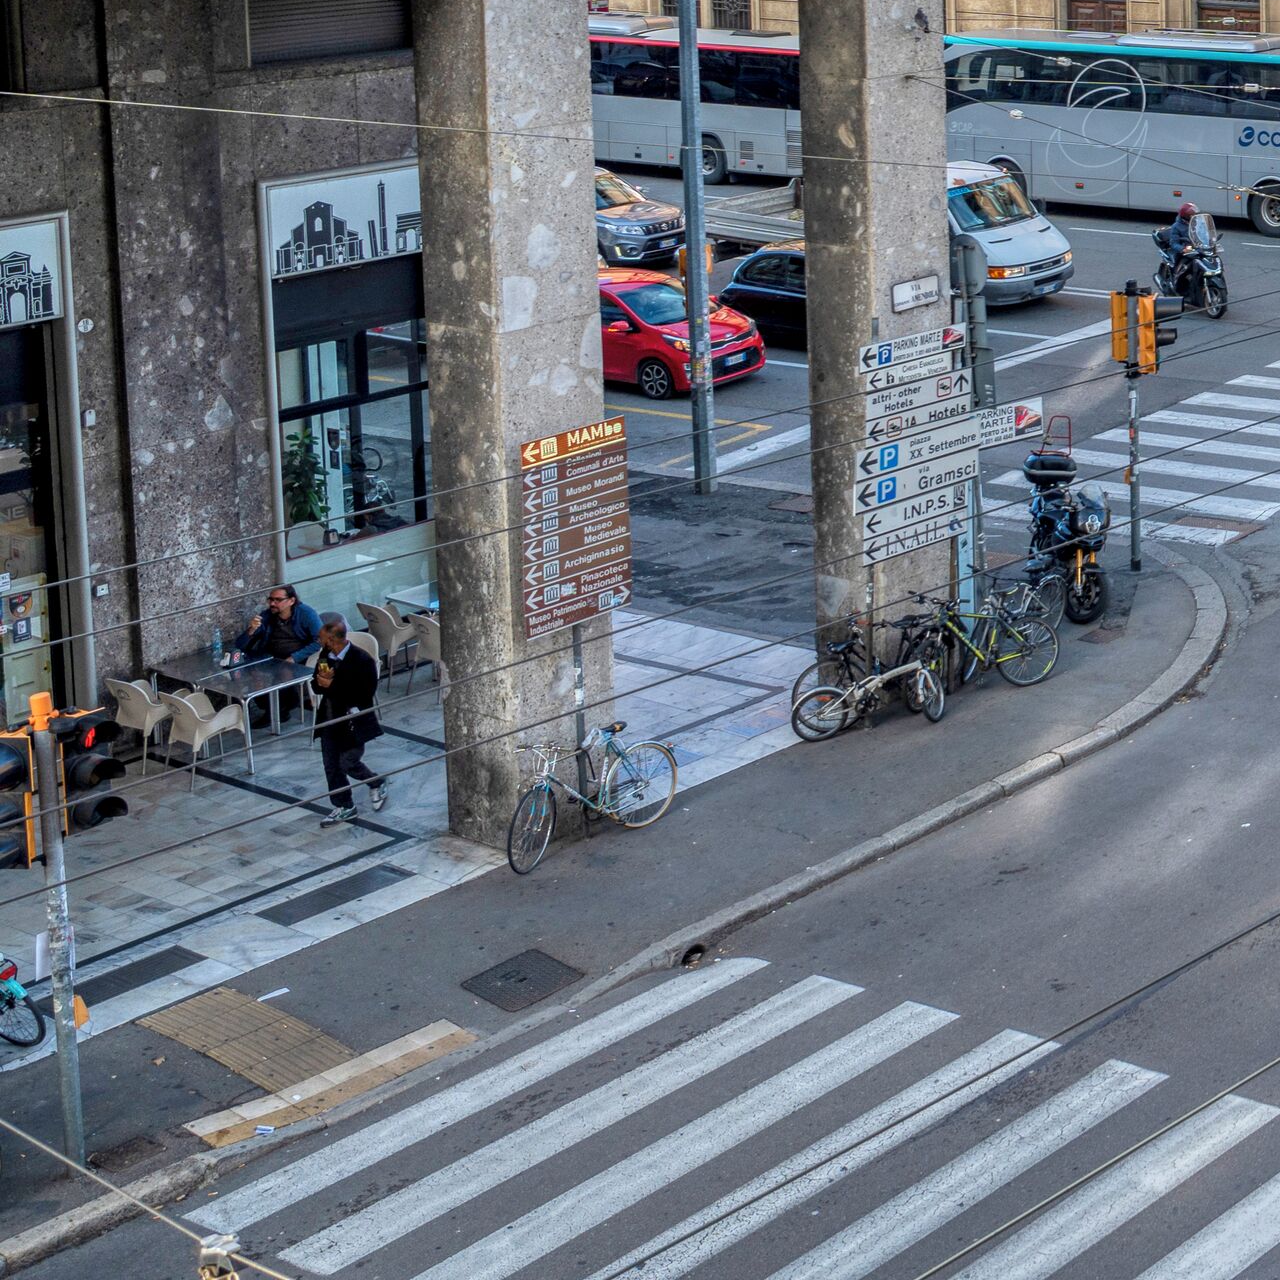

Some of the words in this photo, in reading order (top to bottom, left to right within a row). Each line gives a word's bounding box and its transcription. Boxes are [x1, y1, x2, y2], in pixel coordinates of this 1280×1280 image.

[893, 335, 919, 352] PARKING
[872, 392, 892, 405] altri
[898, 385, 922, 398] other
[884, 399, 914, 413] Hotels
[928, 403, 967, 421] Hotels
[908, 448, 923, 460] XX
[928, 433, 977, 455] Settembre
[909, 435, 932, 448] piazza
[566, 461, 601, 477] Comunali
[602, 454, 624, 467] d'Arte
[918, 460, 976, 490] Gramsci
[919, 464, 930, 474] via
[566, 484, 592, 497] Museo
[594, 472, 625, 488] Morandi
[569, 500, 598, 513] Museo
[569, 501, 626, 524] Archeologico
[903, 495, 950, 521] I.N.P.S.
[583, 520, 613, 535] Museo
[584, 526, 627, 545] Medievale
[885, 521, 946, 556] I.N.A.I.L.
[564, 544, 625, 569] Archiginnasio
[580, 563, 629, 584] Pinacoteca
[581, 574, 624, 594] Nazionale
[529, 612, 552, 626] Museo
[553, 601, 587, 618] Patrimonio
[530, 619, 564, 637] Industriale
